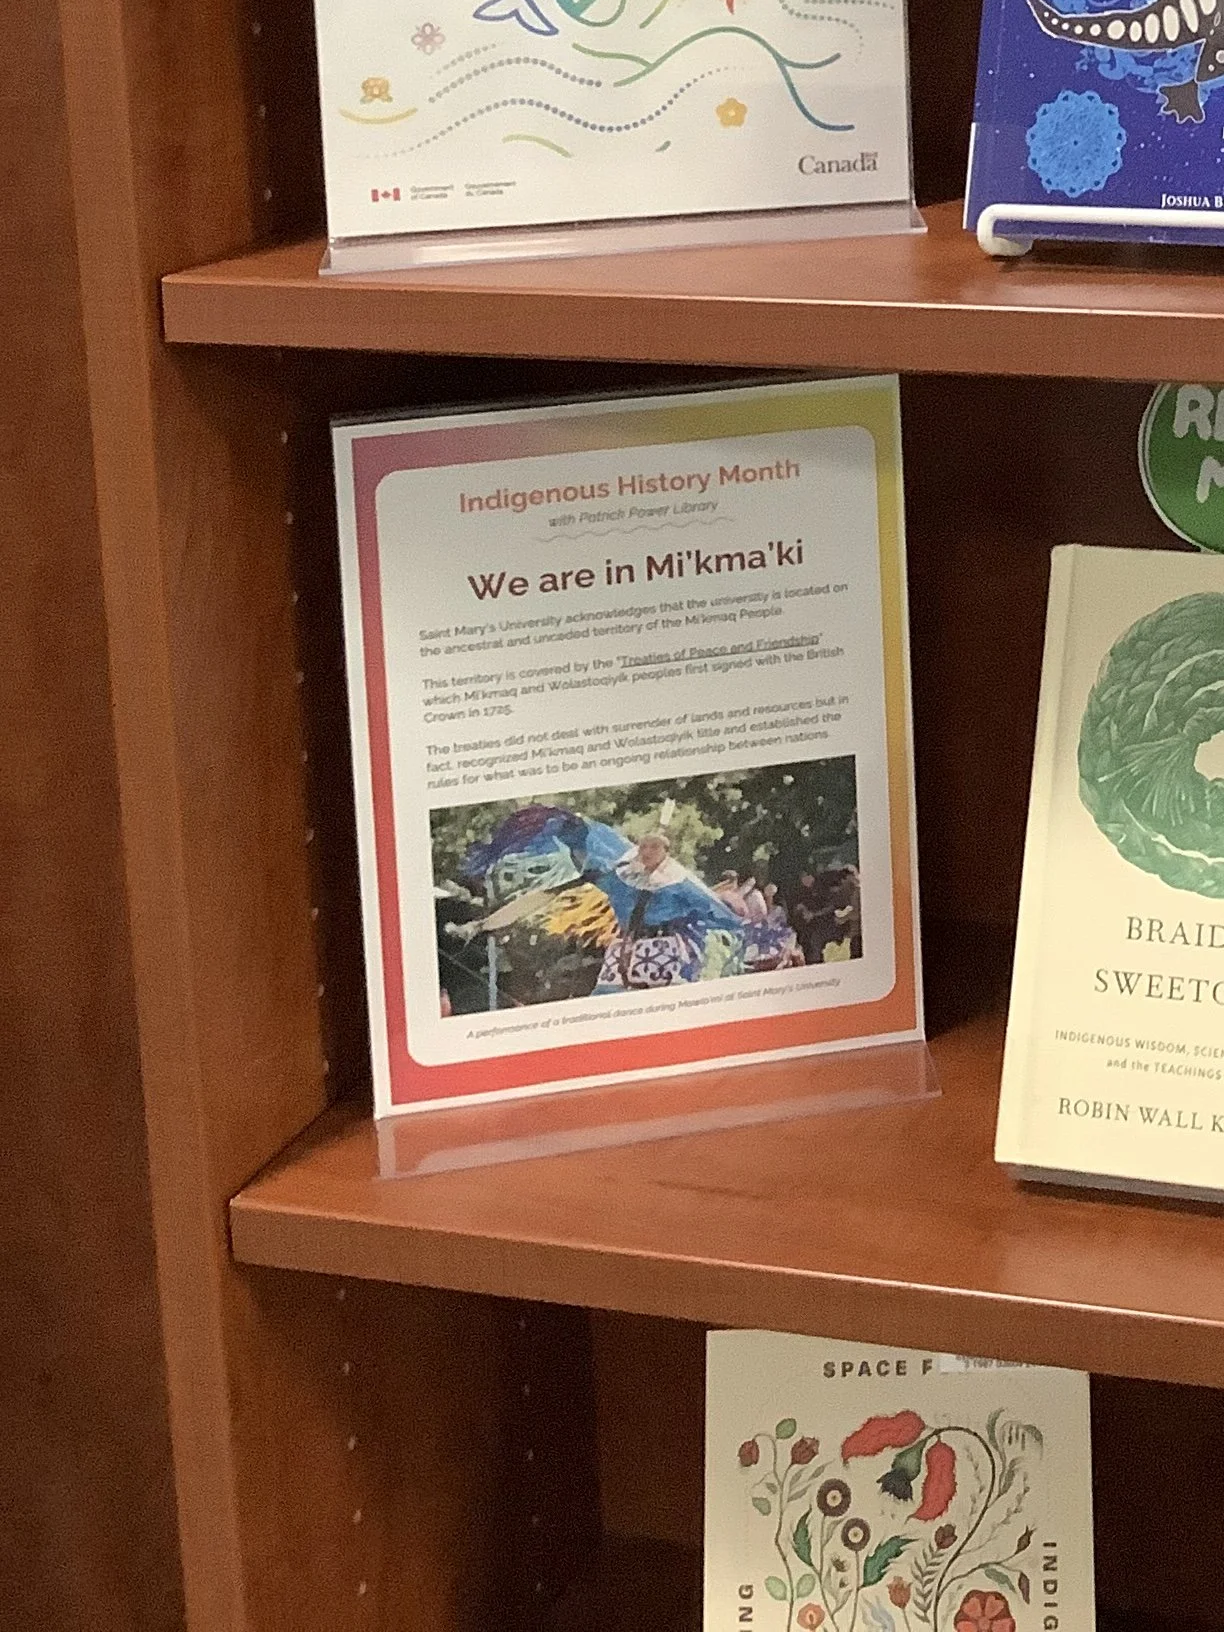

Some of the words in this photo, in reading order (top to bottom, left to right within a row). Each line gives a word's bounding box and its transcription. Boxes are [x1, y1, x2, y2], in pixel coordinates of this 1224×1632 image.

[798, 152, 877, 175] Canada
[1161, 194, 1211, 208] JOSHUA
[459, 479, 610, 513] Indigenous
[618, 470, 711, 497] History
[719, 460, 801, 486] Month
[579, 508, 625, 523] Patrick
[628, 505, 670, 519] Power
[673, 501, 719, 516] Library
[468, 571, 529, 601] We
[538, 567, 595, 594] are
[605, 559, 635, 586] in
[646, 538, 804, 580] Mi'kma'ki
[419, 629, 451, 641] Saint
[454, 623, 496, 638] Mary's
[499, 616, 562, 633] University
[566, 603, 656, 624] acknowledges
[660, 599, 684, 612] that
[687, 596, 707, 609] the
[710, 590, 769, 607] university
[772, 589, 782, 601] is
[784, 583, 830, 599] located
[833, 582, 848, 593] on
[1055, 1029, 1131, 1048] INDIGENOUS
[1135, 1038, 1190, 1056] WISDOM,
[1107, 1058, 1127, 1068] and
[1131, 1059, 1150, 1072] the
[1154, 1062, 1222, 1081] TEACHINGS
[1058, 1097, 1130, 1122] ROBIN
[1138, 1106, 1203, 1130] WALL
[823, 1360, 907, 1378] SPACE
